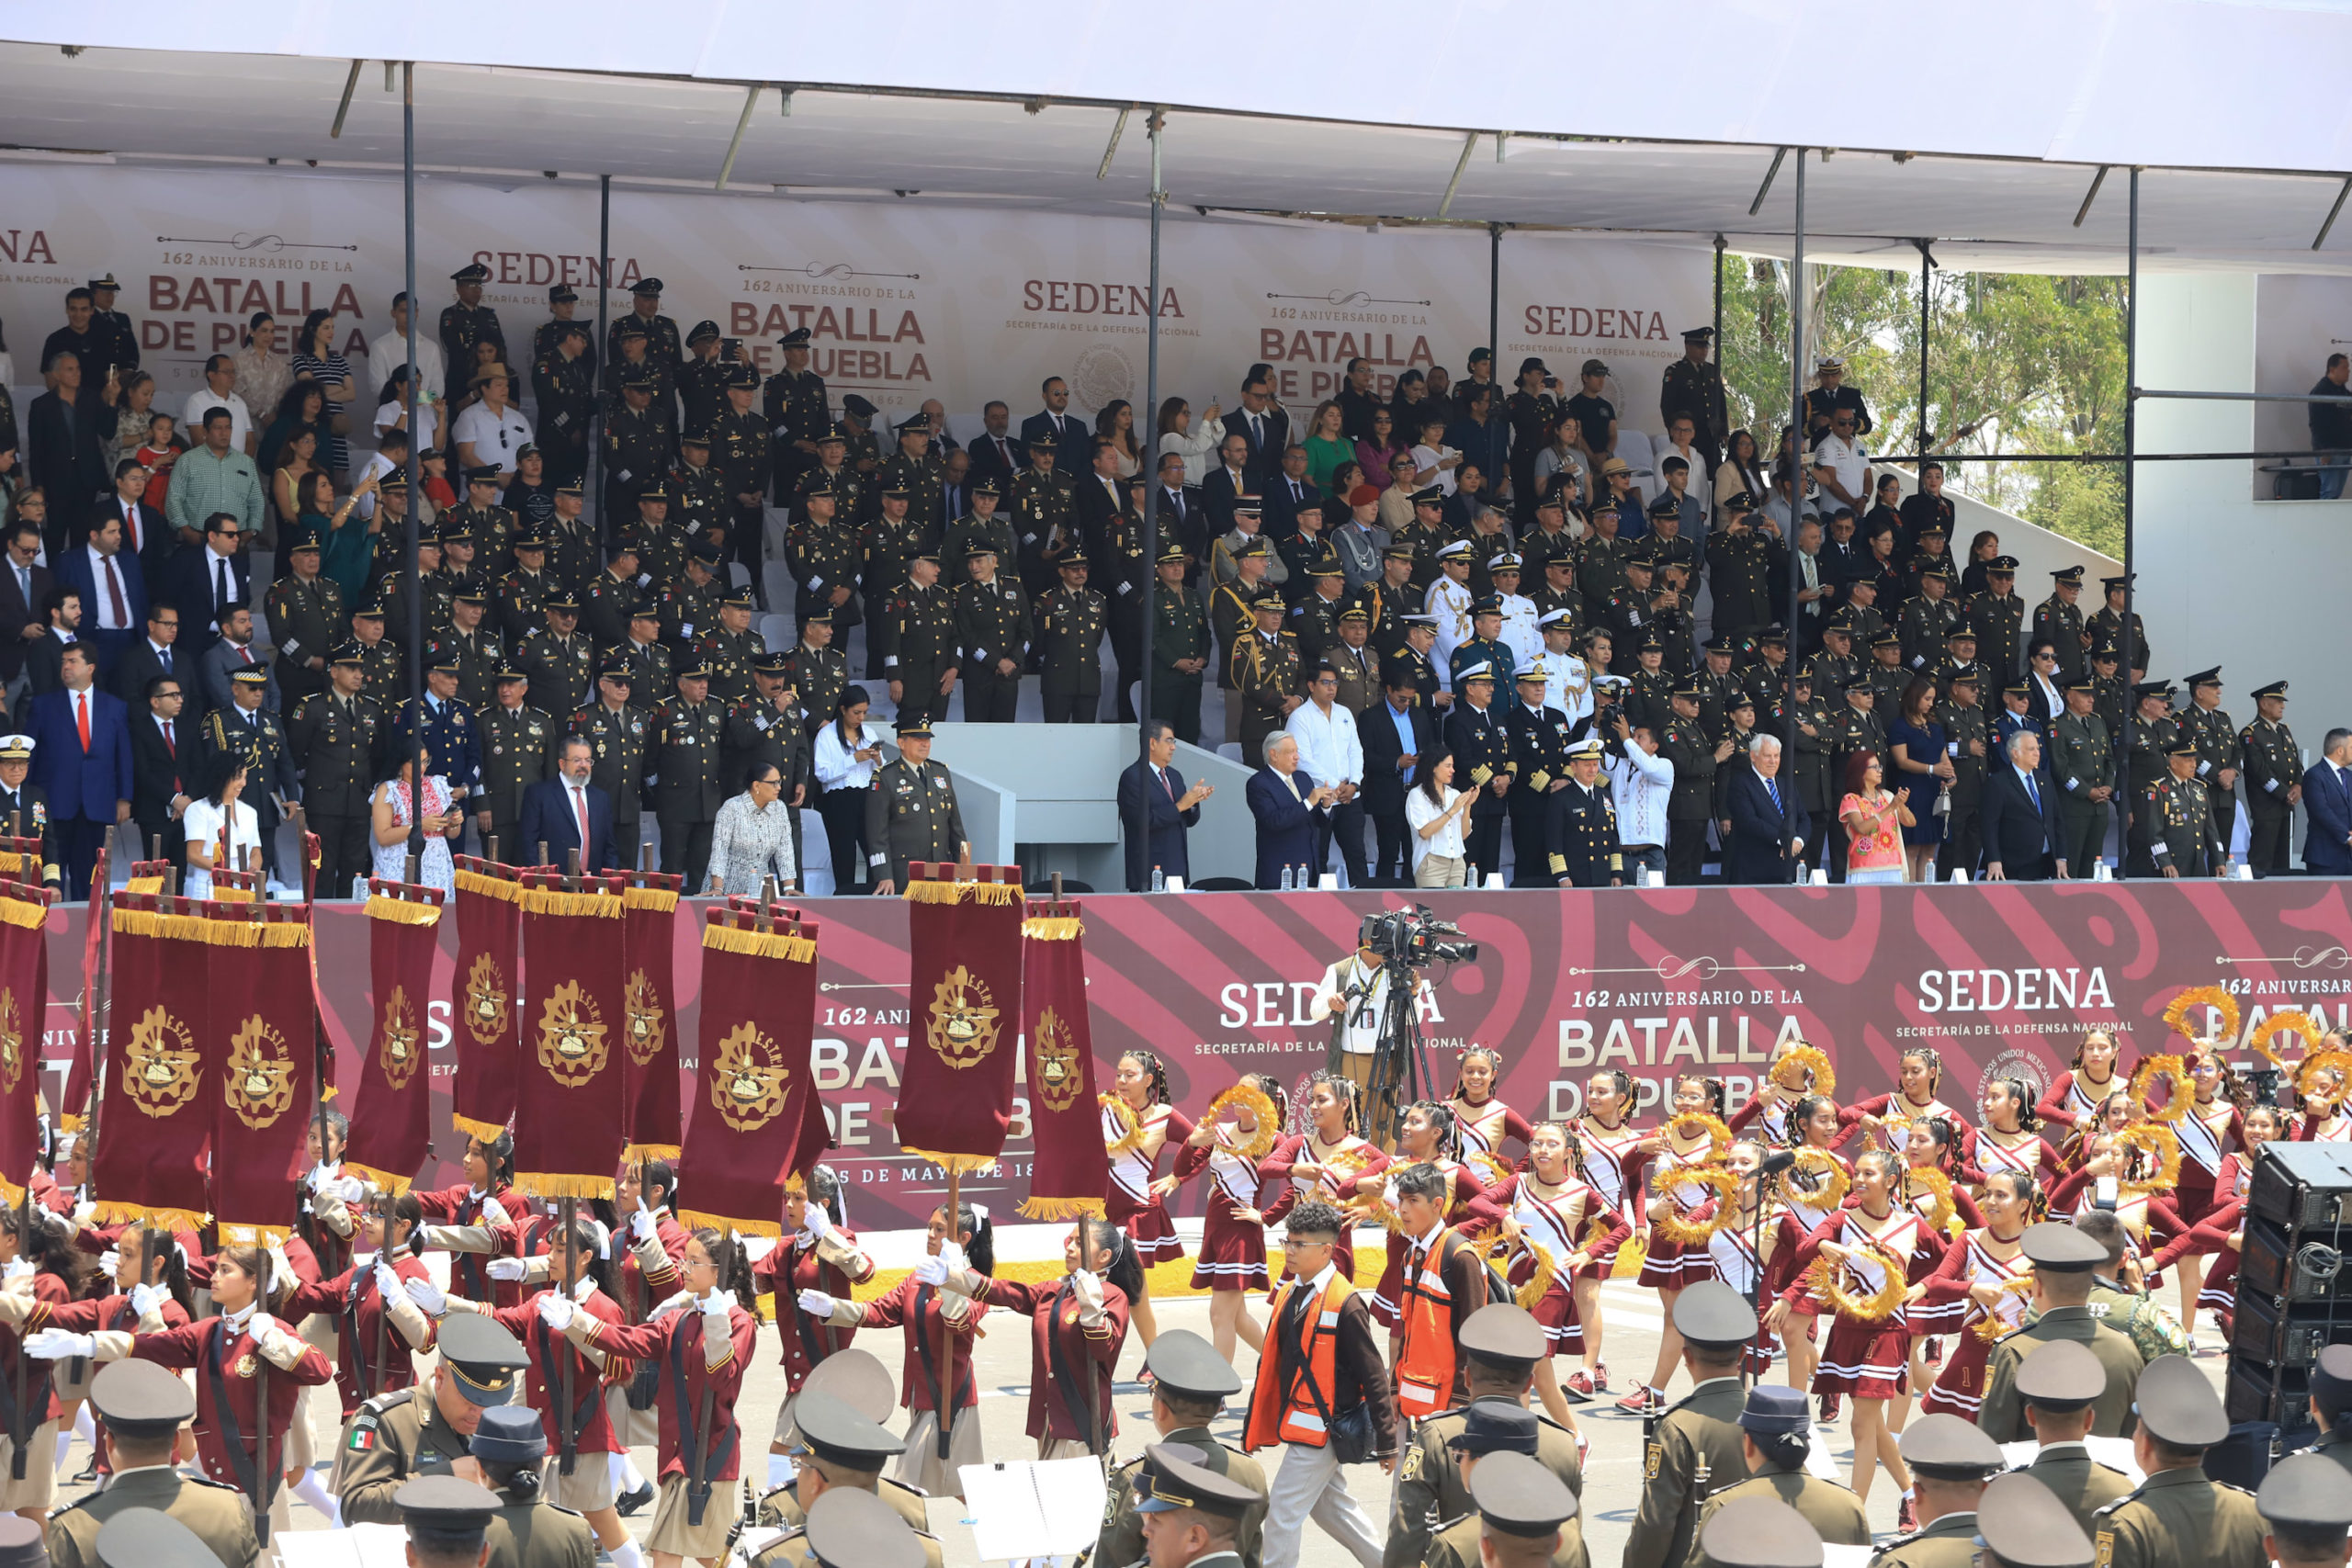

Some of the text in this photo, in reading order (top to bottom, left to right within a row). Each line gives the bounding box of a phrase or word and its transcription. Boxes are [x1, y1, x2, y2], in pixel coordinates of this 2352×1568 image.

[162, 252, 354, 272] 162 ANIVERSARIO DE LA
[149, 275, 364, 319] BATALLA
[742, 279, 916, 299] 162 ANIVERSARIO DE LA
[1023, 279, 1185, 318] SEDENA
[523, 296, 537, 304] DE
[730, 301, 925, 344] BATALLA
[1272, 307, 1427, 325] 162 ANIVERSARIO DE LA
[1524, 305, 1669, 341] SEDENA
[141, 320, 196, 352] DE
[1006, 320, 1202, 337] SECRETARÍA DE LA DEFENSA ACIONAL
[1261, 327, 1435, 367] BATALLA
[1509, 344, 1685, 359] SECRETARÍA DE LA DEFENSA NACIONAL
[812, 347, 932, 382] UEBLA
[1917, 966, 2115, 1013] SEDENA
[2220, 977, 2252, 994] 162
[1572, 989, 1804, 1008] 162 ANIVERSARIO DE LA
[824, 1007, 866, 1026] 162
[1895, 1021, 2133, 1038] SECRETARÍA DE LA DEFENSA NACIONAL
[1194, 1040, 1280, 1055] SECRETARÍA
[1285, 1042, 1303, 1053] DE
[1308, 1041, 1325, 1052] LA
[1977, 1059, 1997, 1096] ESTADOS
[1997, 1049, 2025, 1063] UNIDOS
[1288, 1077, 1310, 1116] ESTADOS
[840, 1169, 849, 1184] 5
[862, 1168, 889, 1183] DE
[1962, 1366, 1971, 1388] 1
